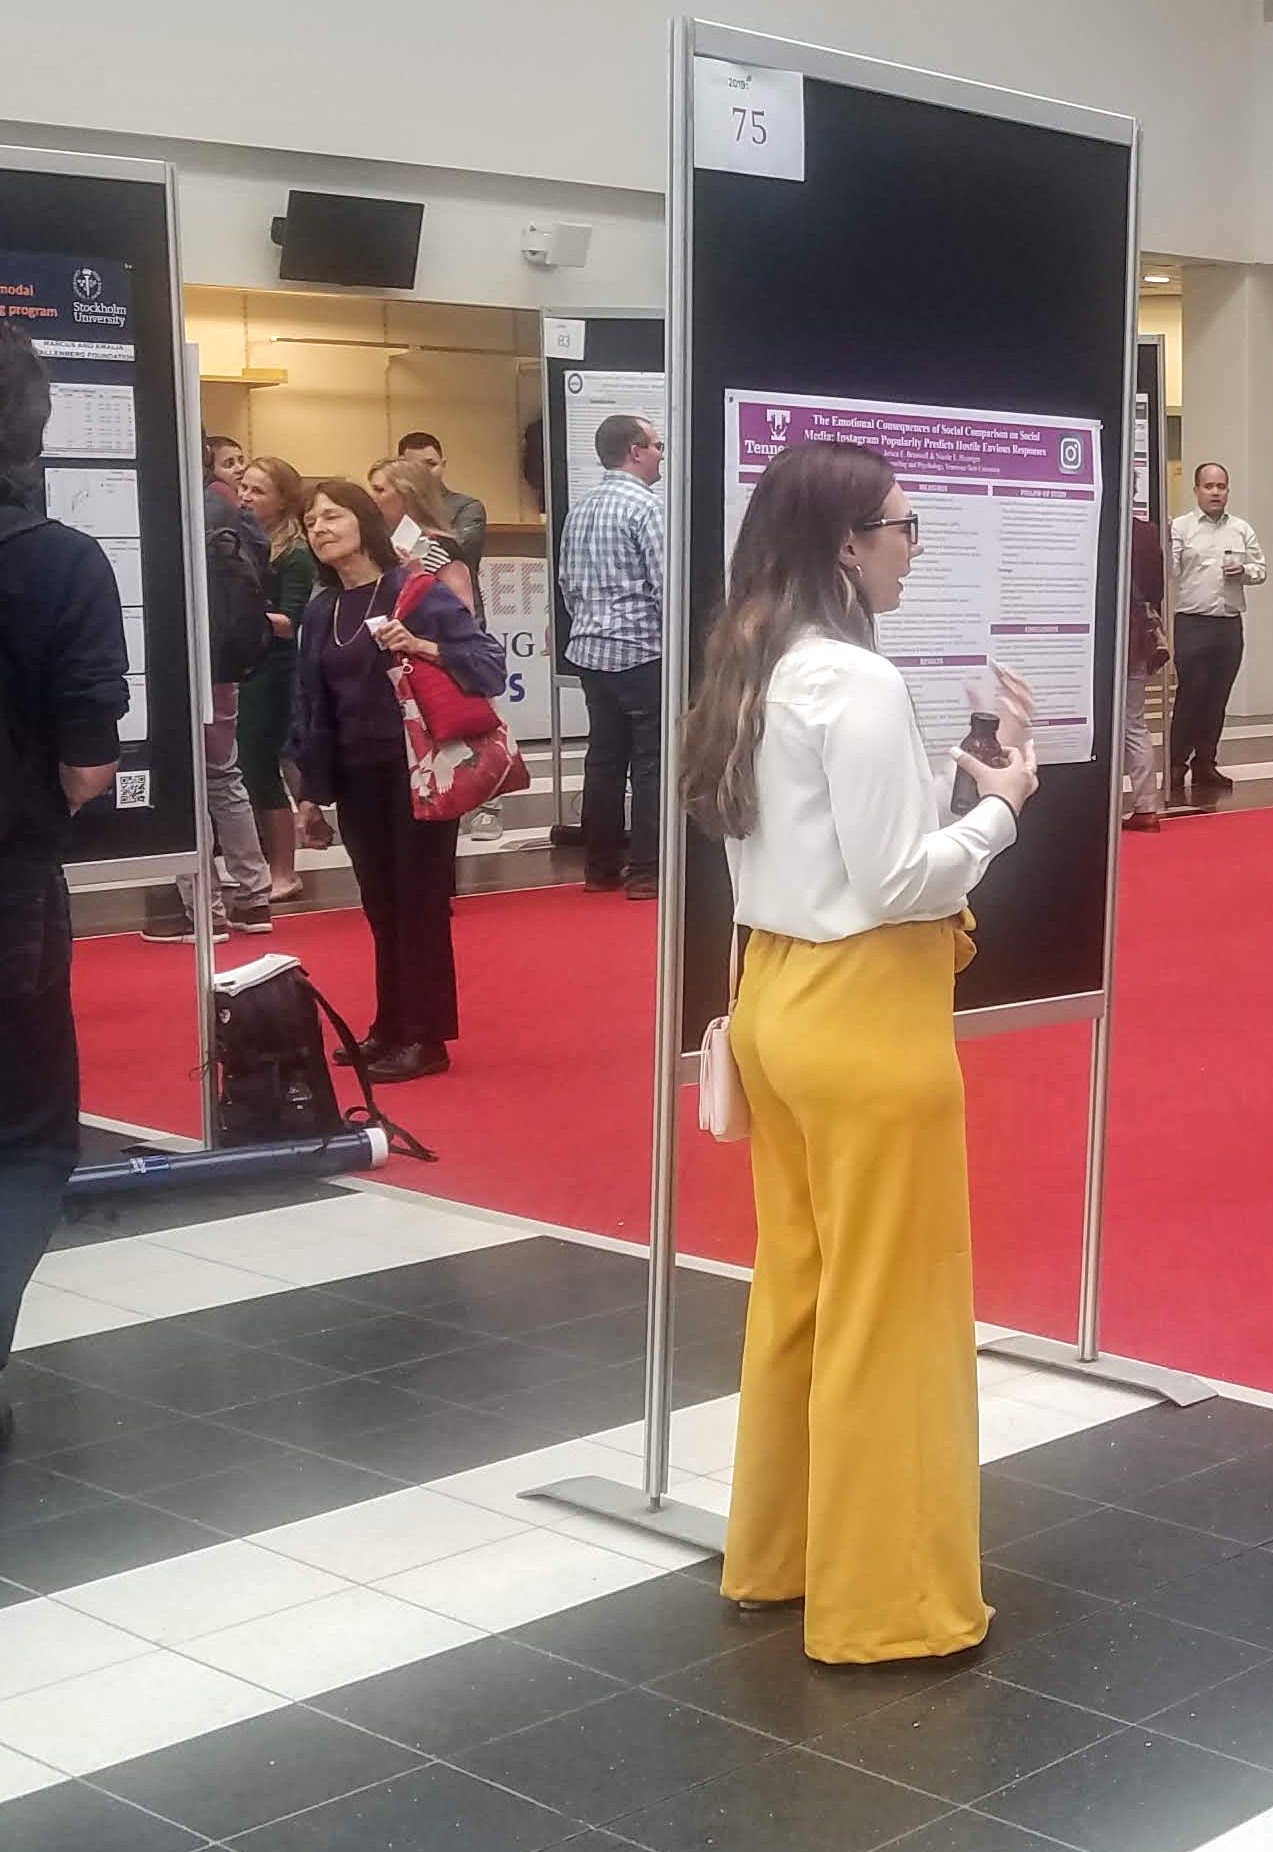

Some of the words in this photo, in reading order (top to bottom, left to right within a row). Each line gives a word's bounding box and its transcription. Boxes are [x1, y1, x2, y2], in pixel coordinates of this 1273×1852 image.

[733, 107, 767, 145] 75
[9, 305, 58, 319] program
[73, 302, 127, 315] Stockholm
[74, 312, 126, 328] University
[812, 414, 830, 426] The
[832, 415, 874, 429] Emotional
[876, 419, 930, 434] Consequences
[932, 423, 941, 434] of
[941, 424, 964, 436] Social
[965, 426, 1008, 440] Comparison
[1019, 430, 1041, 442] Social
[745, 440, 785, 455] Tenne
[804, 429, 835, 442] Media:
[836, 431, 879, 446] Instagram
[881, 435, 922, 450] Popularity
[924, 437, 954, 451] Predicts
[955, 440, 981, 452] Hostile
[982, 442, 1011, 454] Envious
[1012, 444, 1047, 458] Responses
